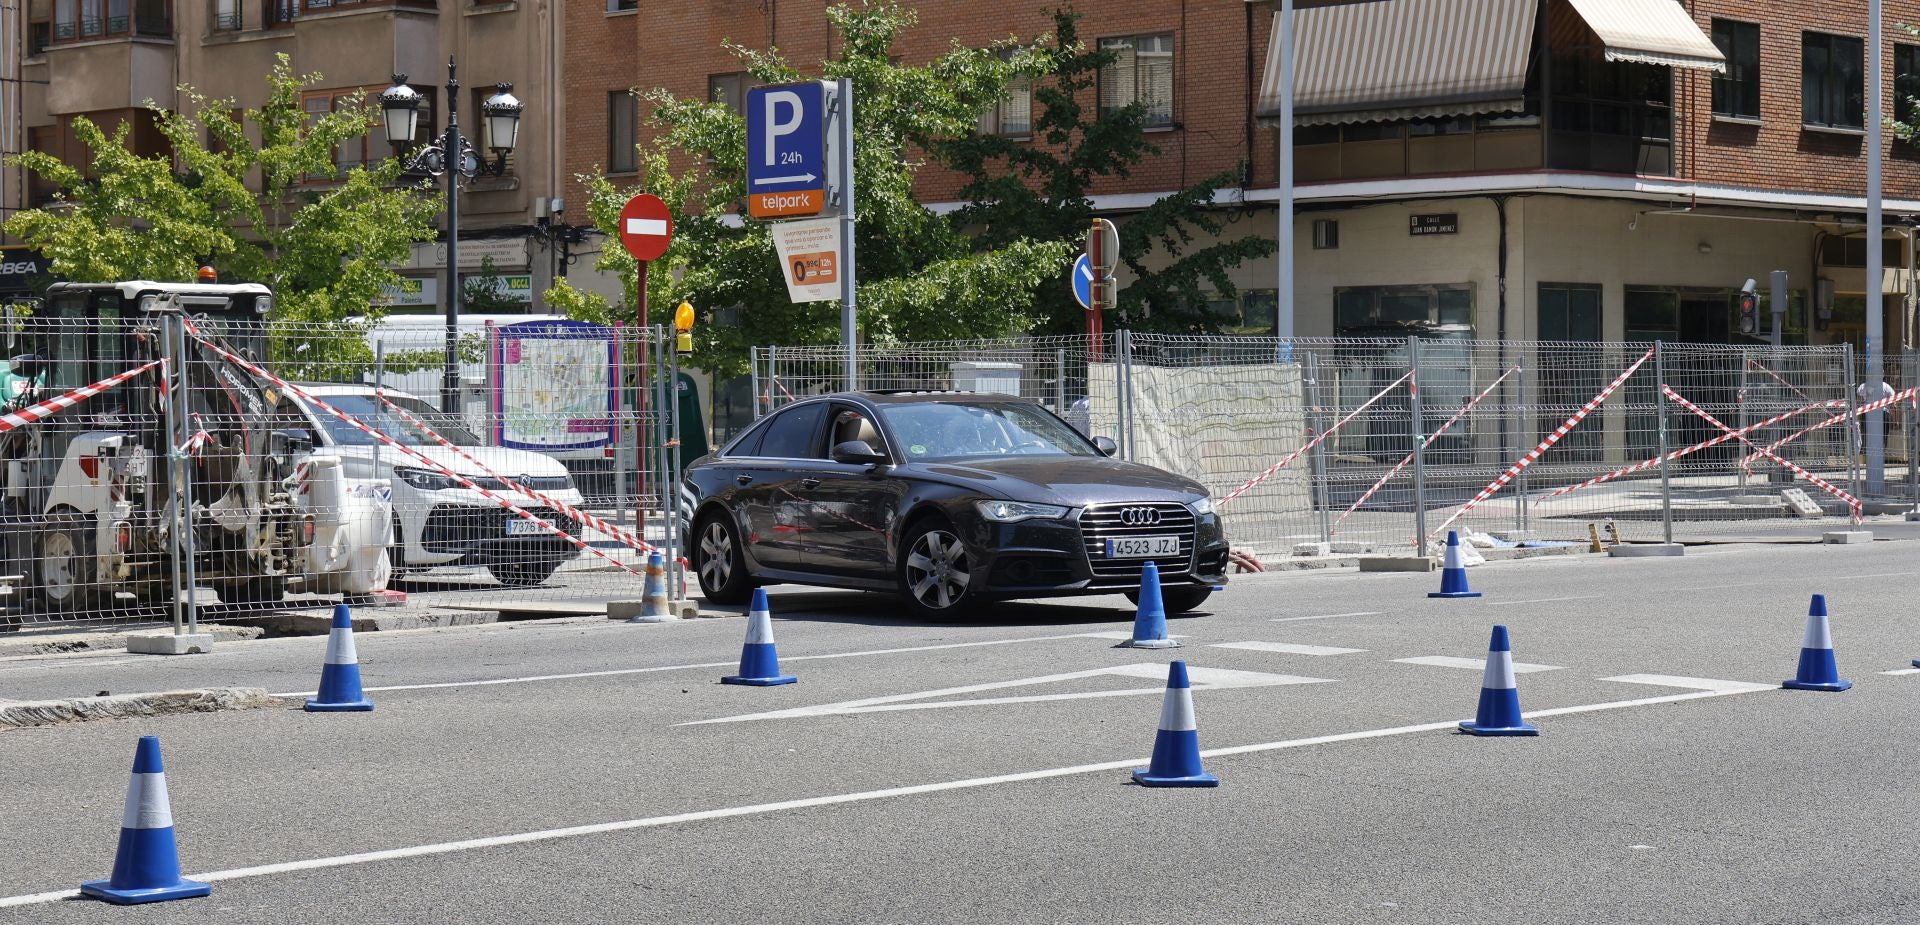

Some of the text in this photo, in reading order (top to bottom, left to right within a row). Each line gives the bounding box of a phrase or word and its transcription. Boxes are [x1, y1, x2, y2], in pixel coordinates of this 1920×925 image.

[765, 90, 804, 166] P
[781, 151, 803, 165] 24h
[762, 194, 810, 211] telpark
[512, 521, 536, 533] 7376
[1116, 539, 1177, 555] 4523 JZJ
